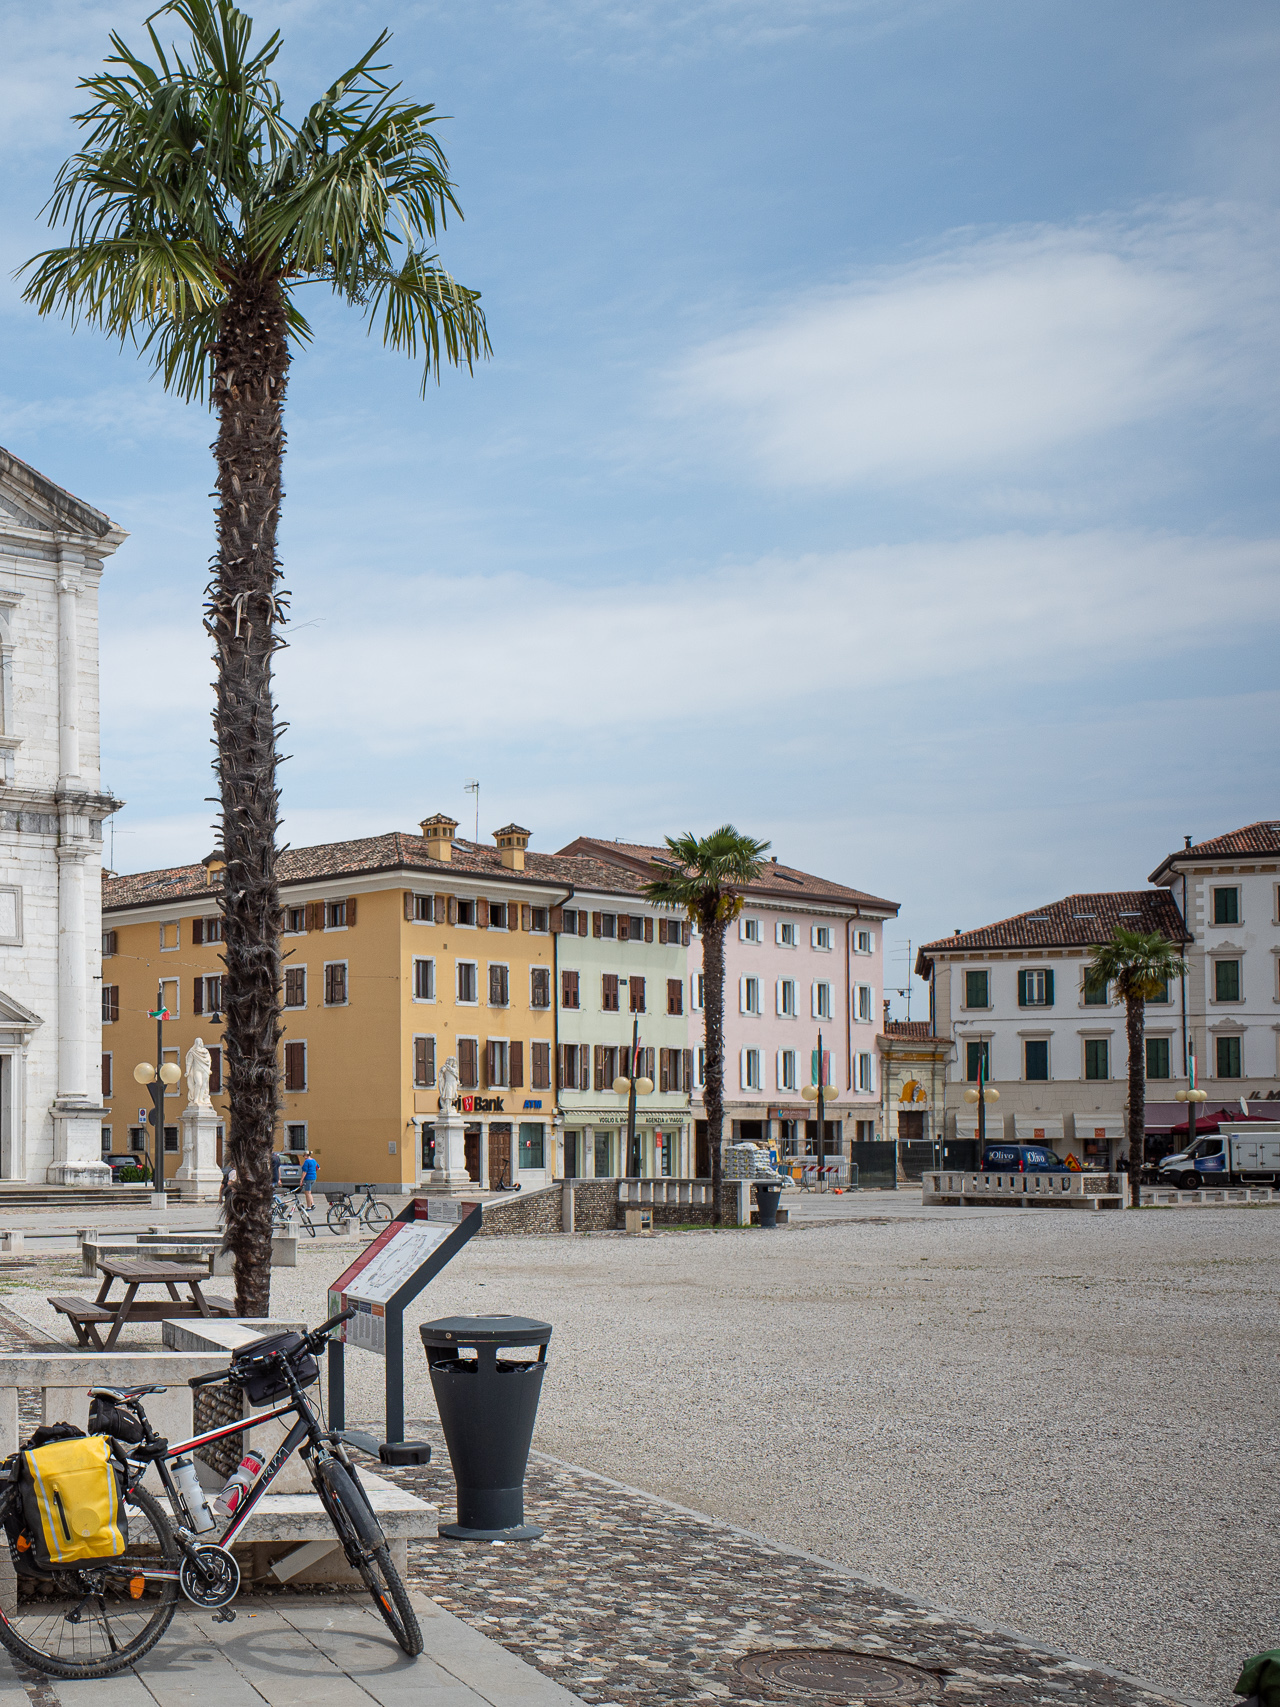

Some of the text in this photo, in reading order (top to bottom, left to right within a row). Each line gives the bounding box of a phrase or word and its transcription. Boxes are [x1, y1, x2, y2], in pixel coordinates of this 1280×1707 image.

[473, 1096, 505, 1112] Bank
[523, 1100, 542, 1109] ATM
[991, 1151, 1014, 1160] Olivo
[1028, 1151, 1045, 1163] Olivo
